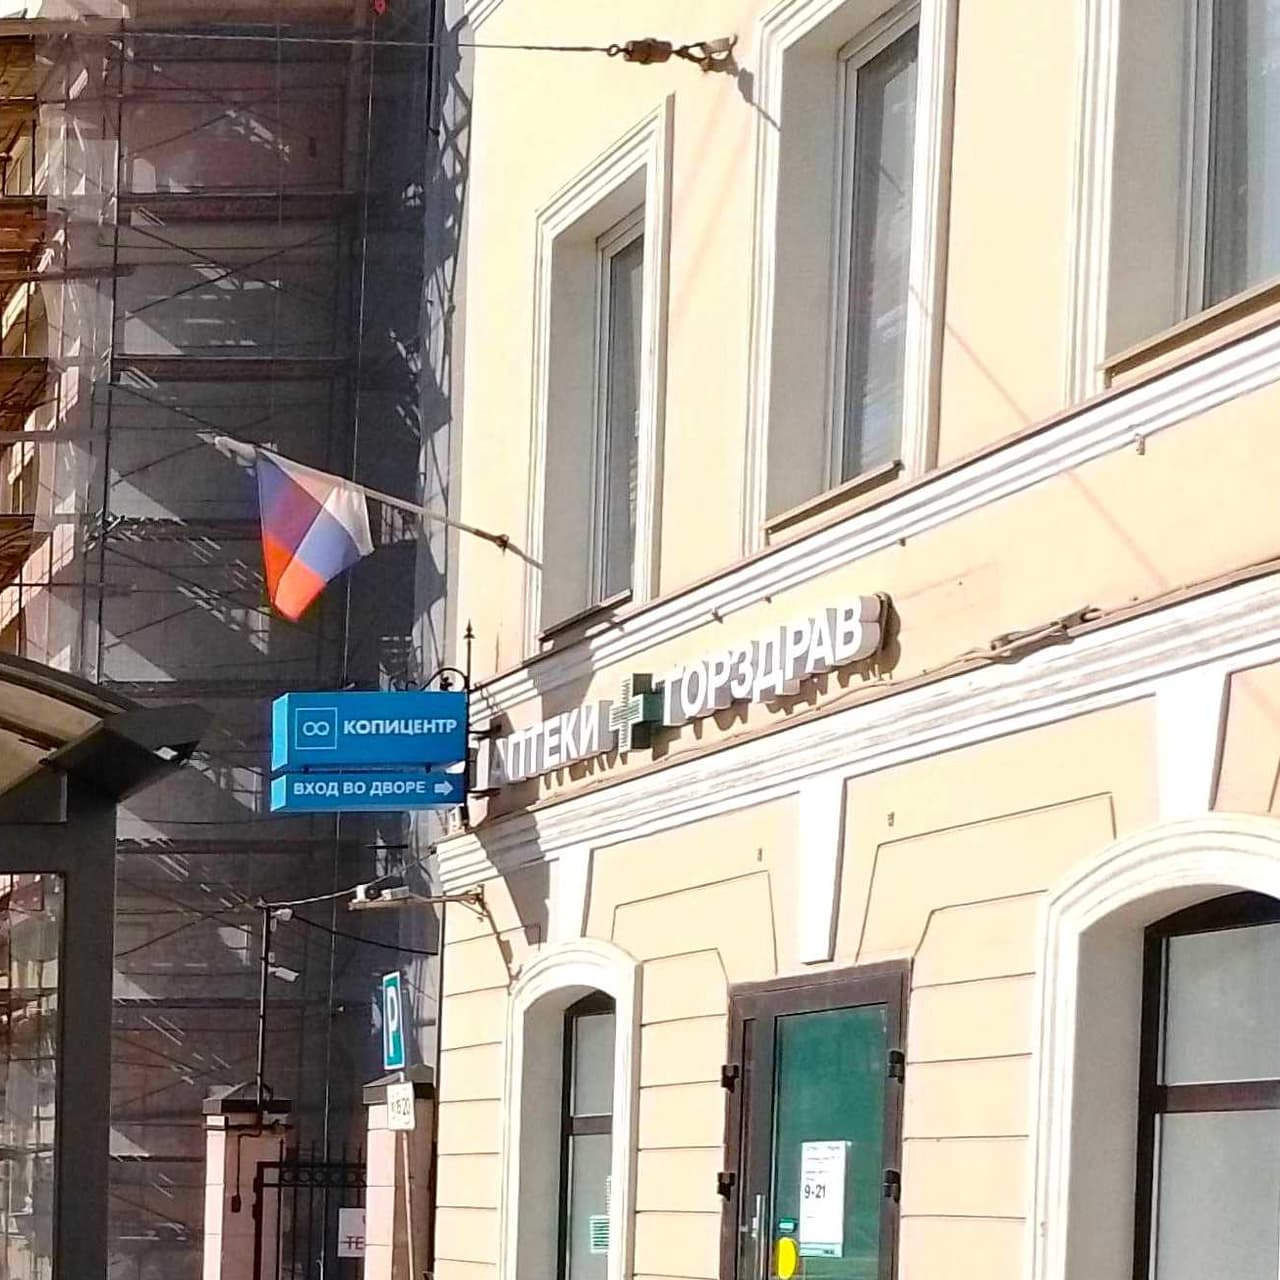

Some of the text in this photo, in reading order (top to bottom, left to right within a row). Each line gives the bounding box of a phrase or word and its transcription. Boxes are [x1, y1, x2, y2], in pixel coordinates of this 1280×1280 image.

[343, 719, 458, 736] КОПИЦЕНТР
[293, 781, 427, 797] ВХОД ВО ДВОРЕ
